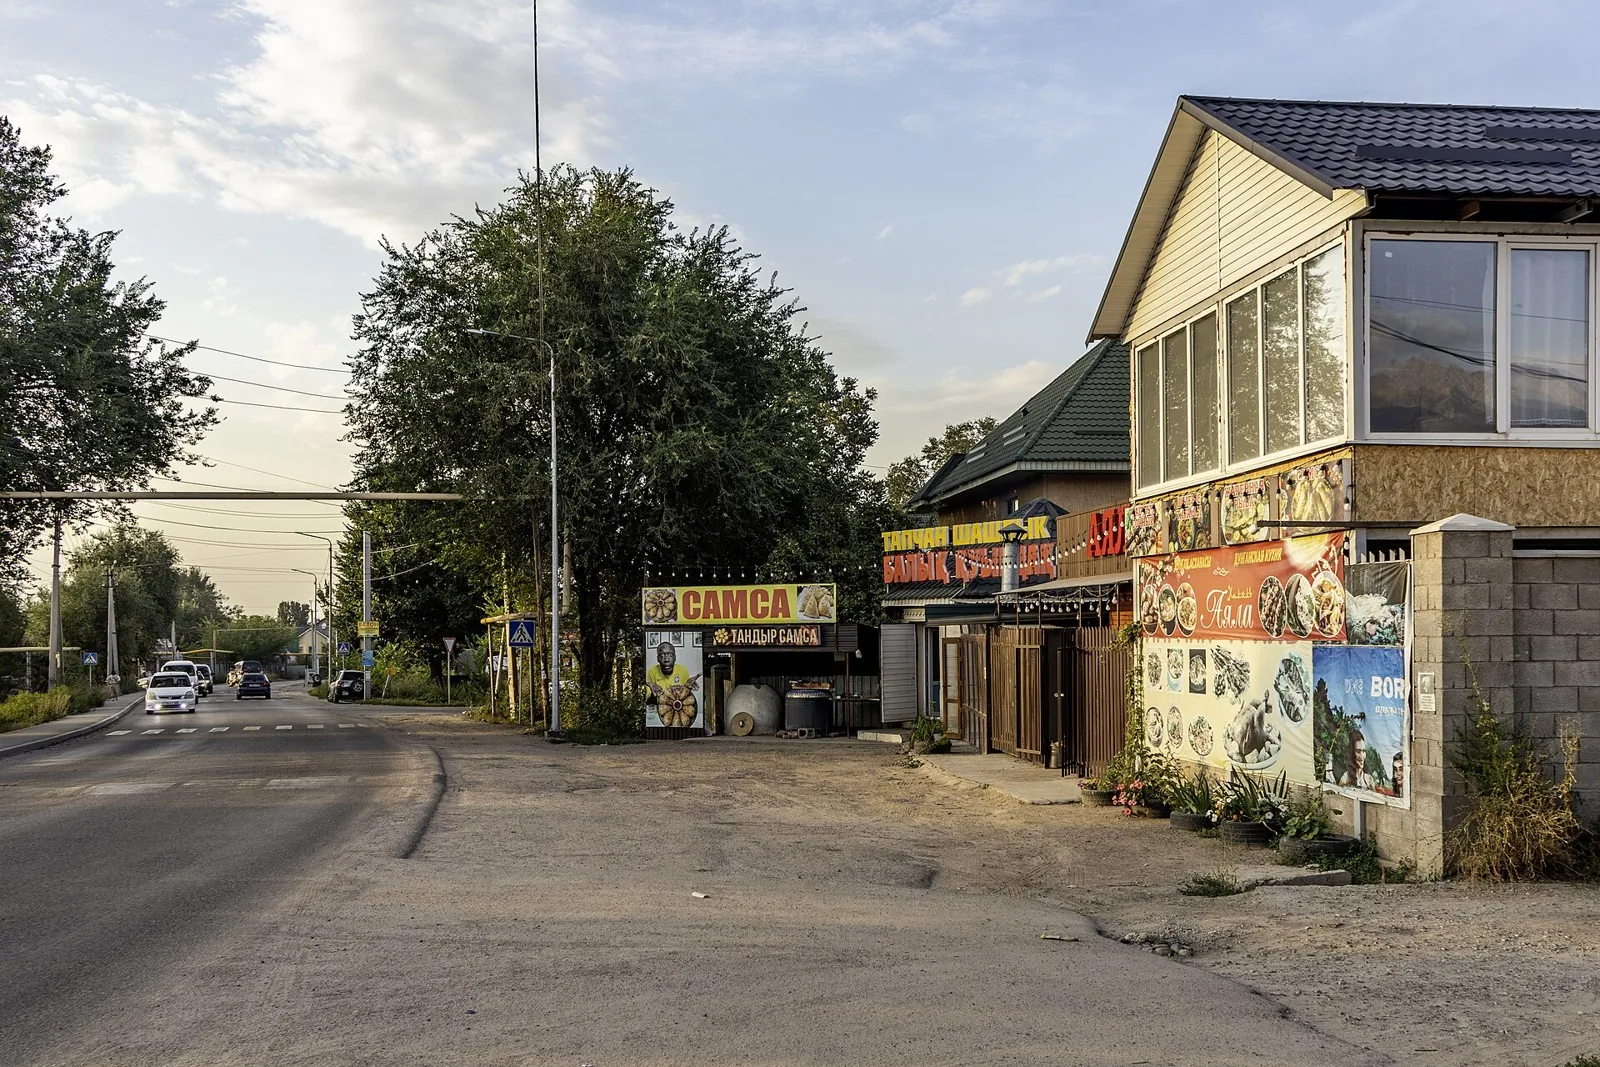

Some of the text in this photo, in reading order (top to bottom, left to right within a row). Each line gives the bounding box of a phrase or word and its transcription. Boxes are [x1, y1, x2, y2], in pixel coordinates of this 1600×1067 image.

[881, 526, 949, 552] ТАПЧАН
[883, 542, 1056, 584] БАЛЫҚ ҚУЫДАҚ
[682, 588, 791, 620] САМСА
[731, 628, 818, 645] ТАНДЫР САМСА
